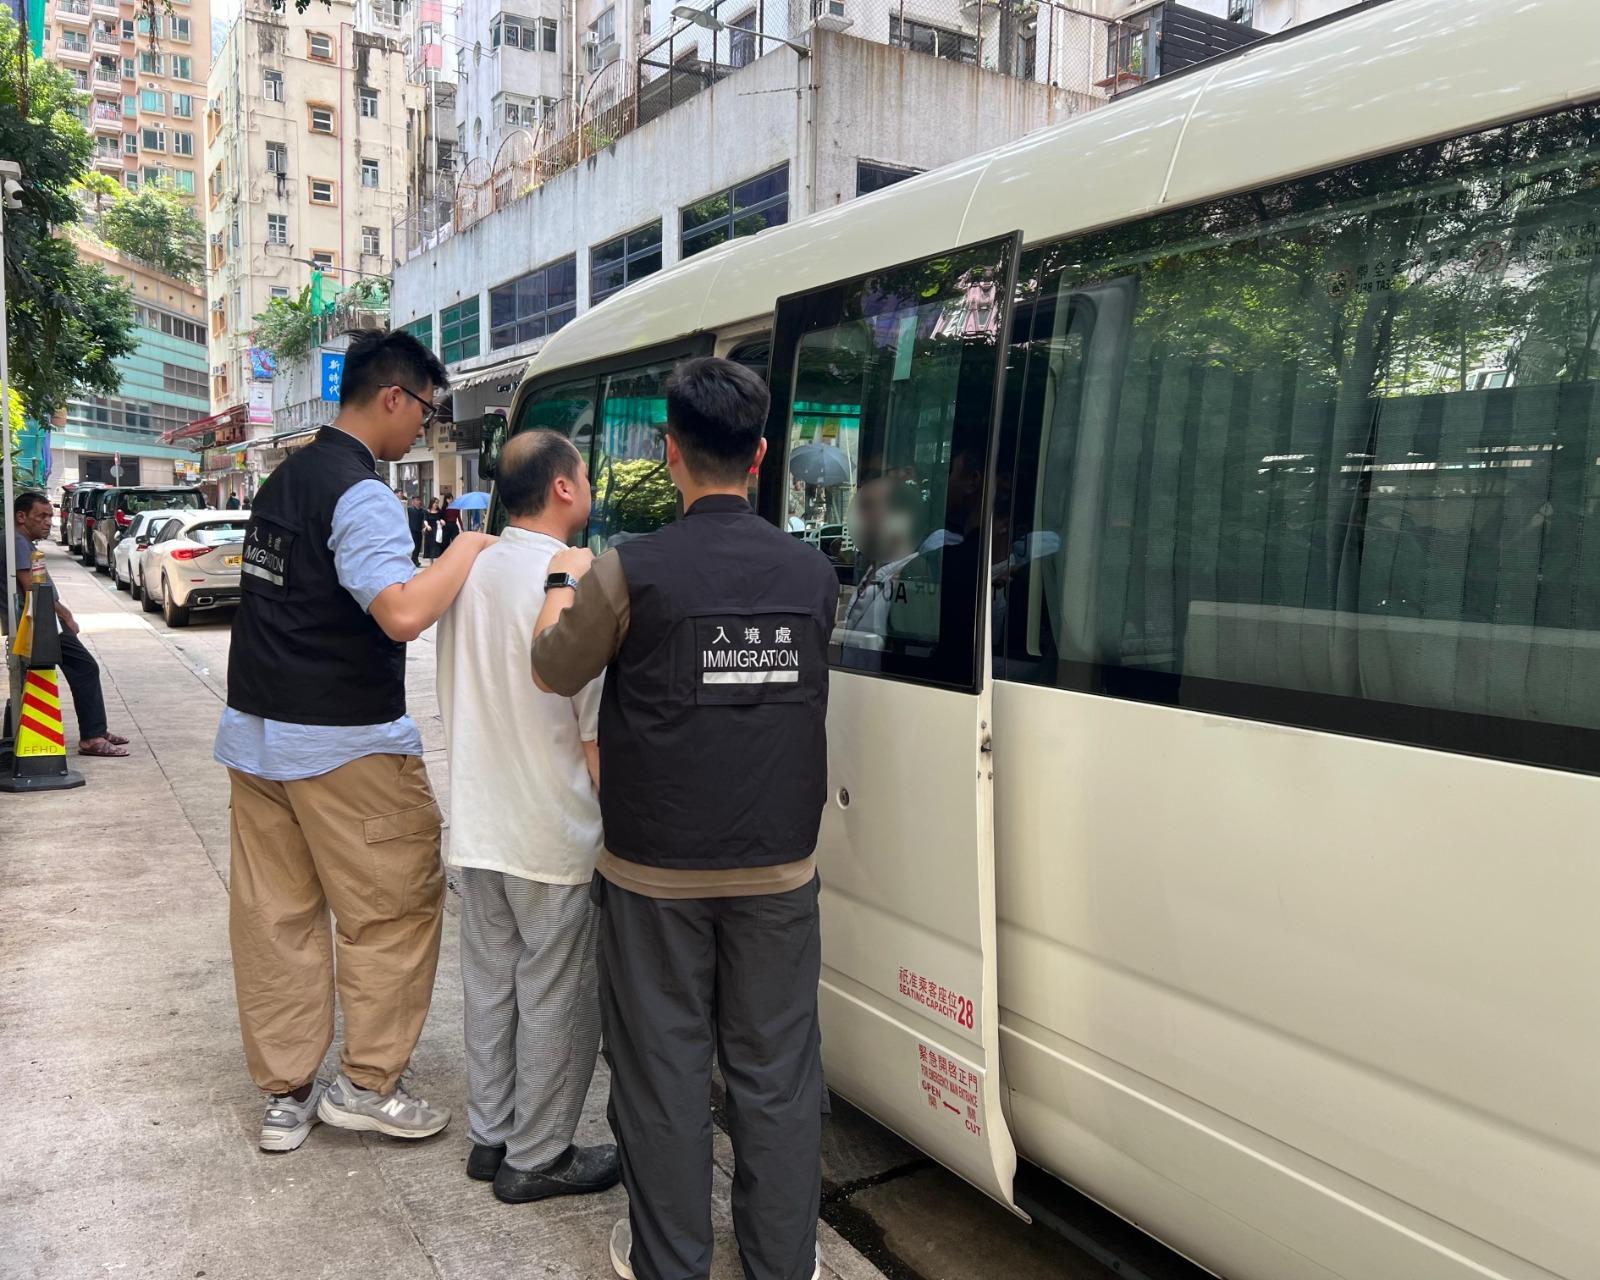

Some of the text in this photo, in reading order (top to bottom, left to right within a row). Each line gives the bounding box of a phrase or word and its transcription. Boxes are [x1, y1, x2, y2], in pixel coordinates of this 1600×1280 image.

[328, 359, 341, 396] 新時代
[712, 626, 792, 644] 入境處
[703, 650, 798, 668] IMMIGRATION
[23, 745, 57, 754] FEHD
[899, 983, 957, 1021] SEATING CAPACITY
[957, 995, 974, 1029] 28
[921, 1080, 941, 1099] OPEN
